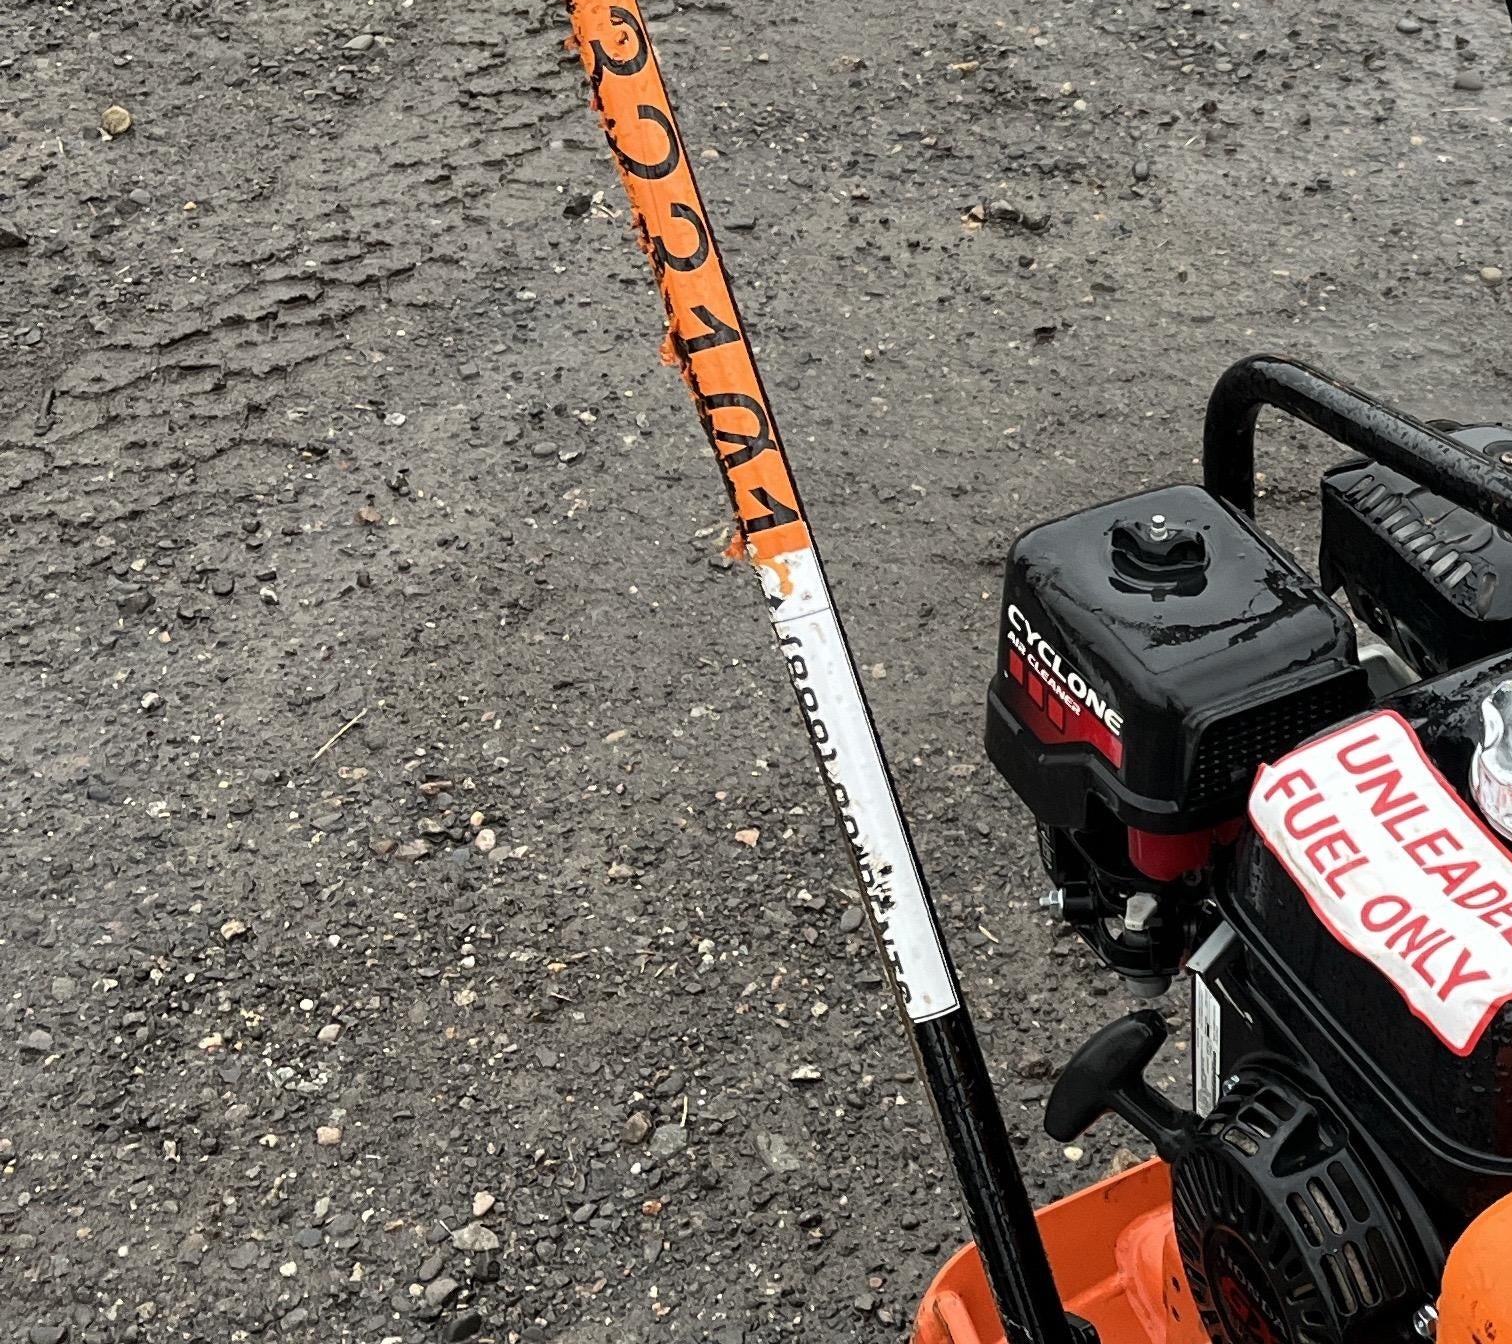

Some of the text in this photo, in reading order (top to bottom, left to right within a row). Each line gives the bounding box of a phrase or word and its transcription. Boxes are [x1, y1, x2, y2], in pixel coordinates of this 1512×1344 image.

[1007, 604, 1124, 736] CYCLONE
[1007, 630, 1082, 717] AIR CLEANER
[1263, 766, 1491, 1004] FUEL ONLY
